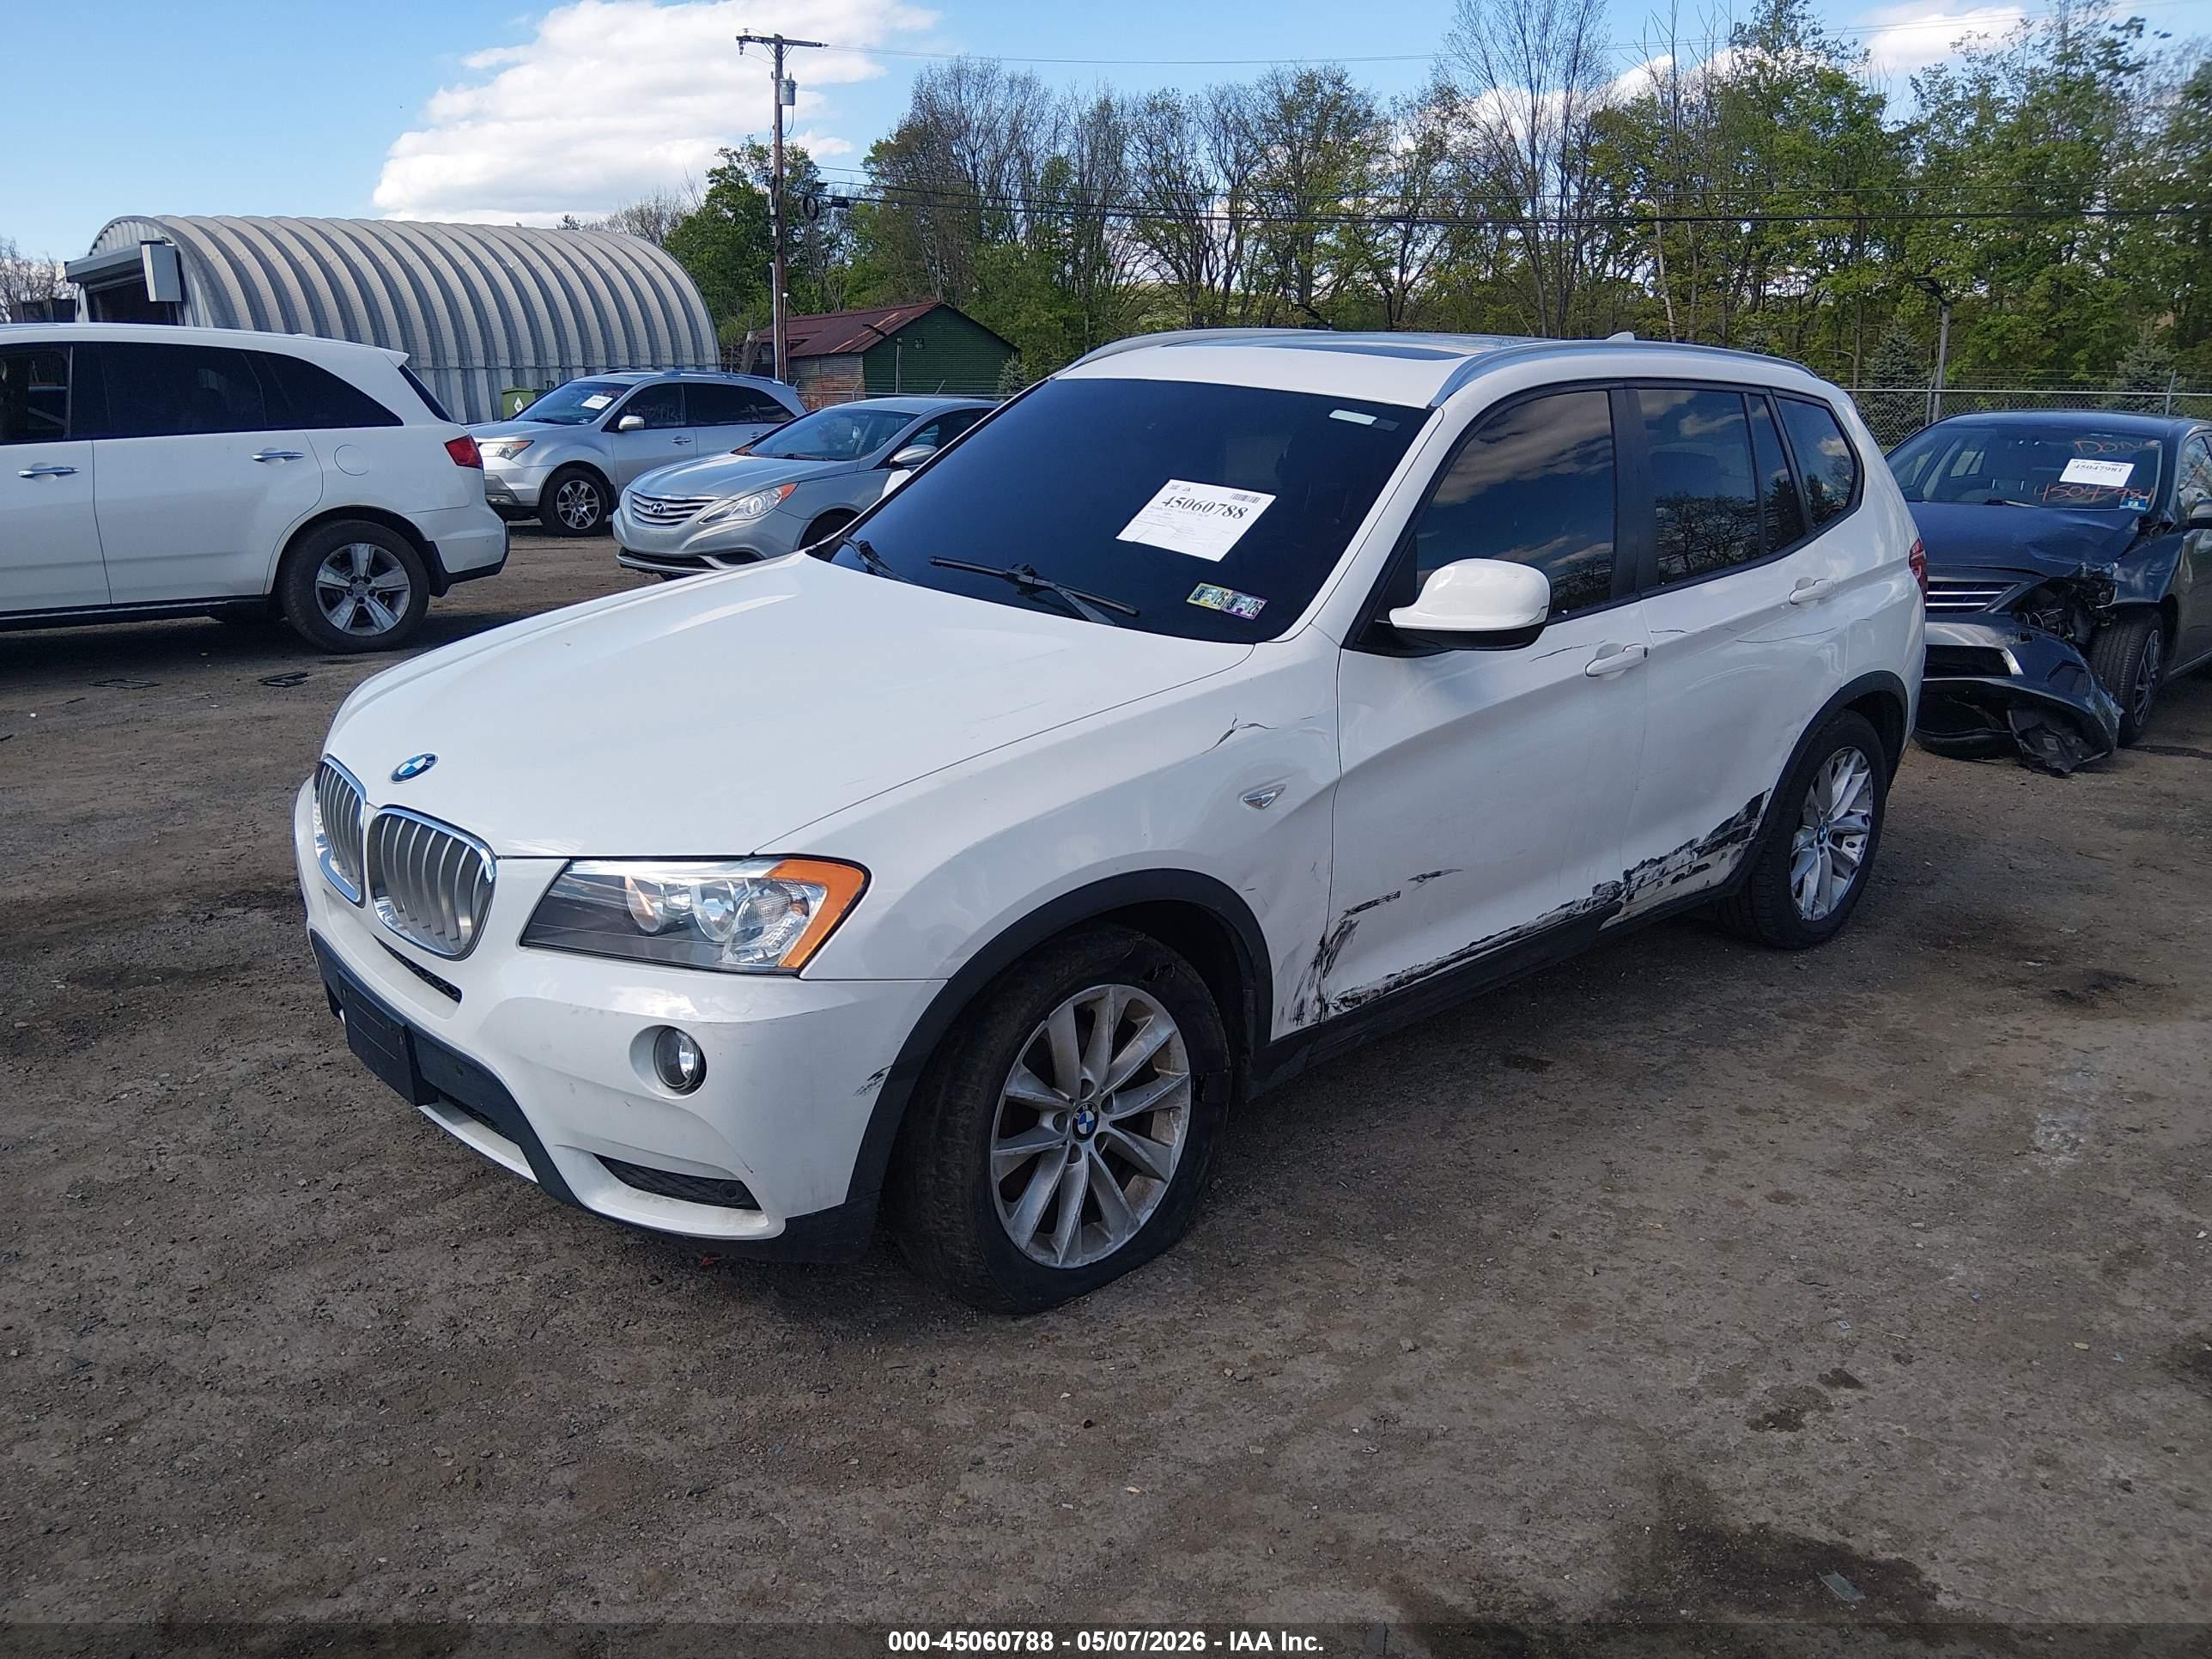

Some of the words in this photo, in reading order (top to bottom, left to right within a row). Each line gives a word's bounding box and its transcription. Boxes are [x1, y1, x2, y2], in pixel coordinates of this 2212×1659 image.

[2074, 439, 2162, 455] DON
[1162, 495, 1249, 520] 45060788
[1213, 591, 1229, 605] 26
[1247, 601, 1263, 616] 26
